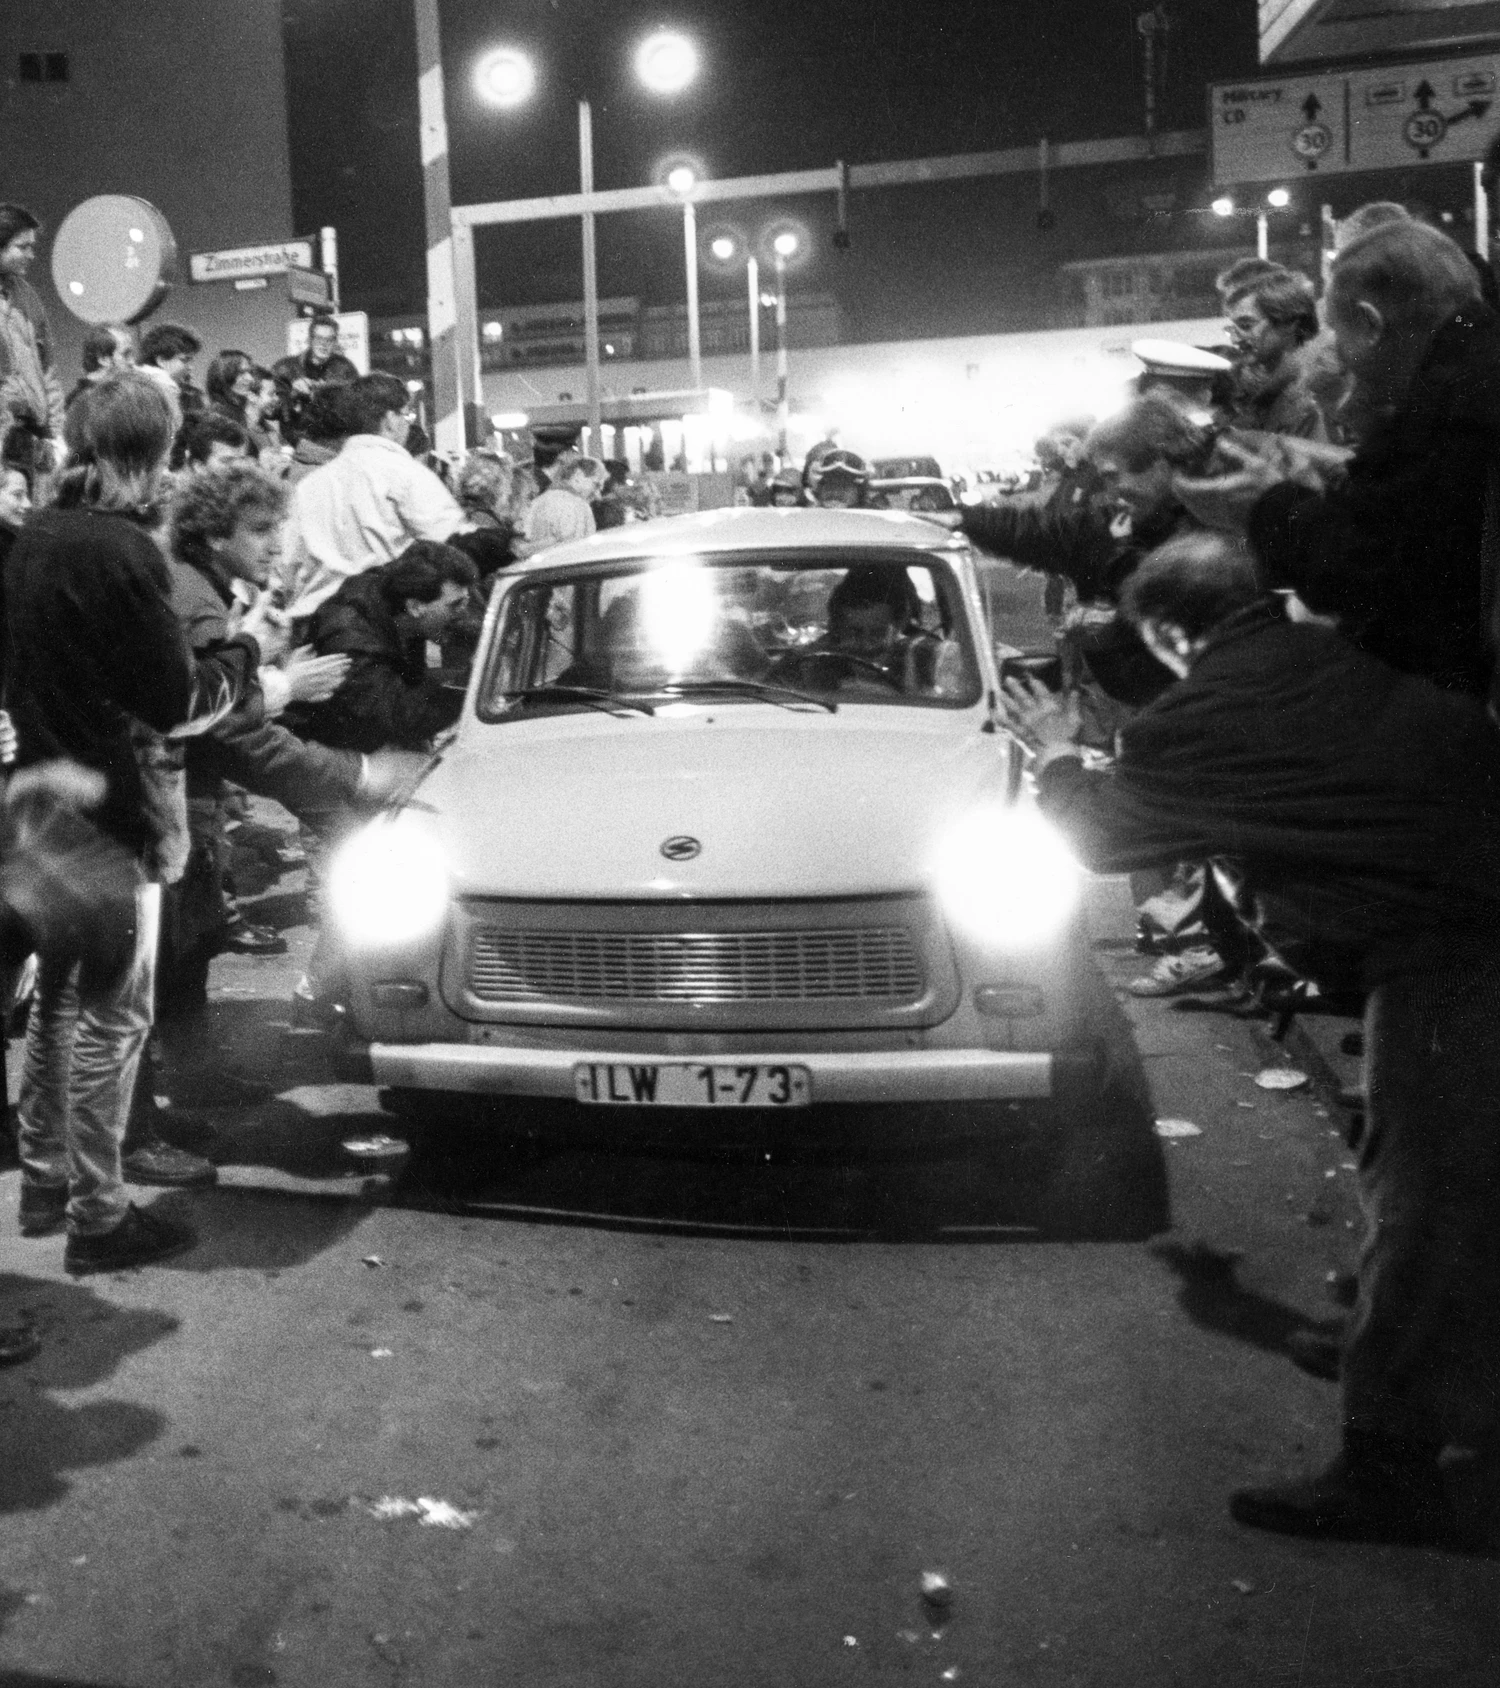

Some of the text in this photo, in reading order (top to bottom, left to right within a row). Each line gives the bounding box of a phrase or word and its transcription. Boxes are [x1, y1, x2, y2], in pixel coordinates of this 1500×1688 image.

[1414, 119, 1438, 137] 30
[1303, 131, 1326, 151] 30
[588, 1064, 790, 1103] ILW 1-73
